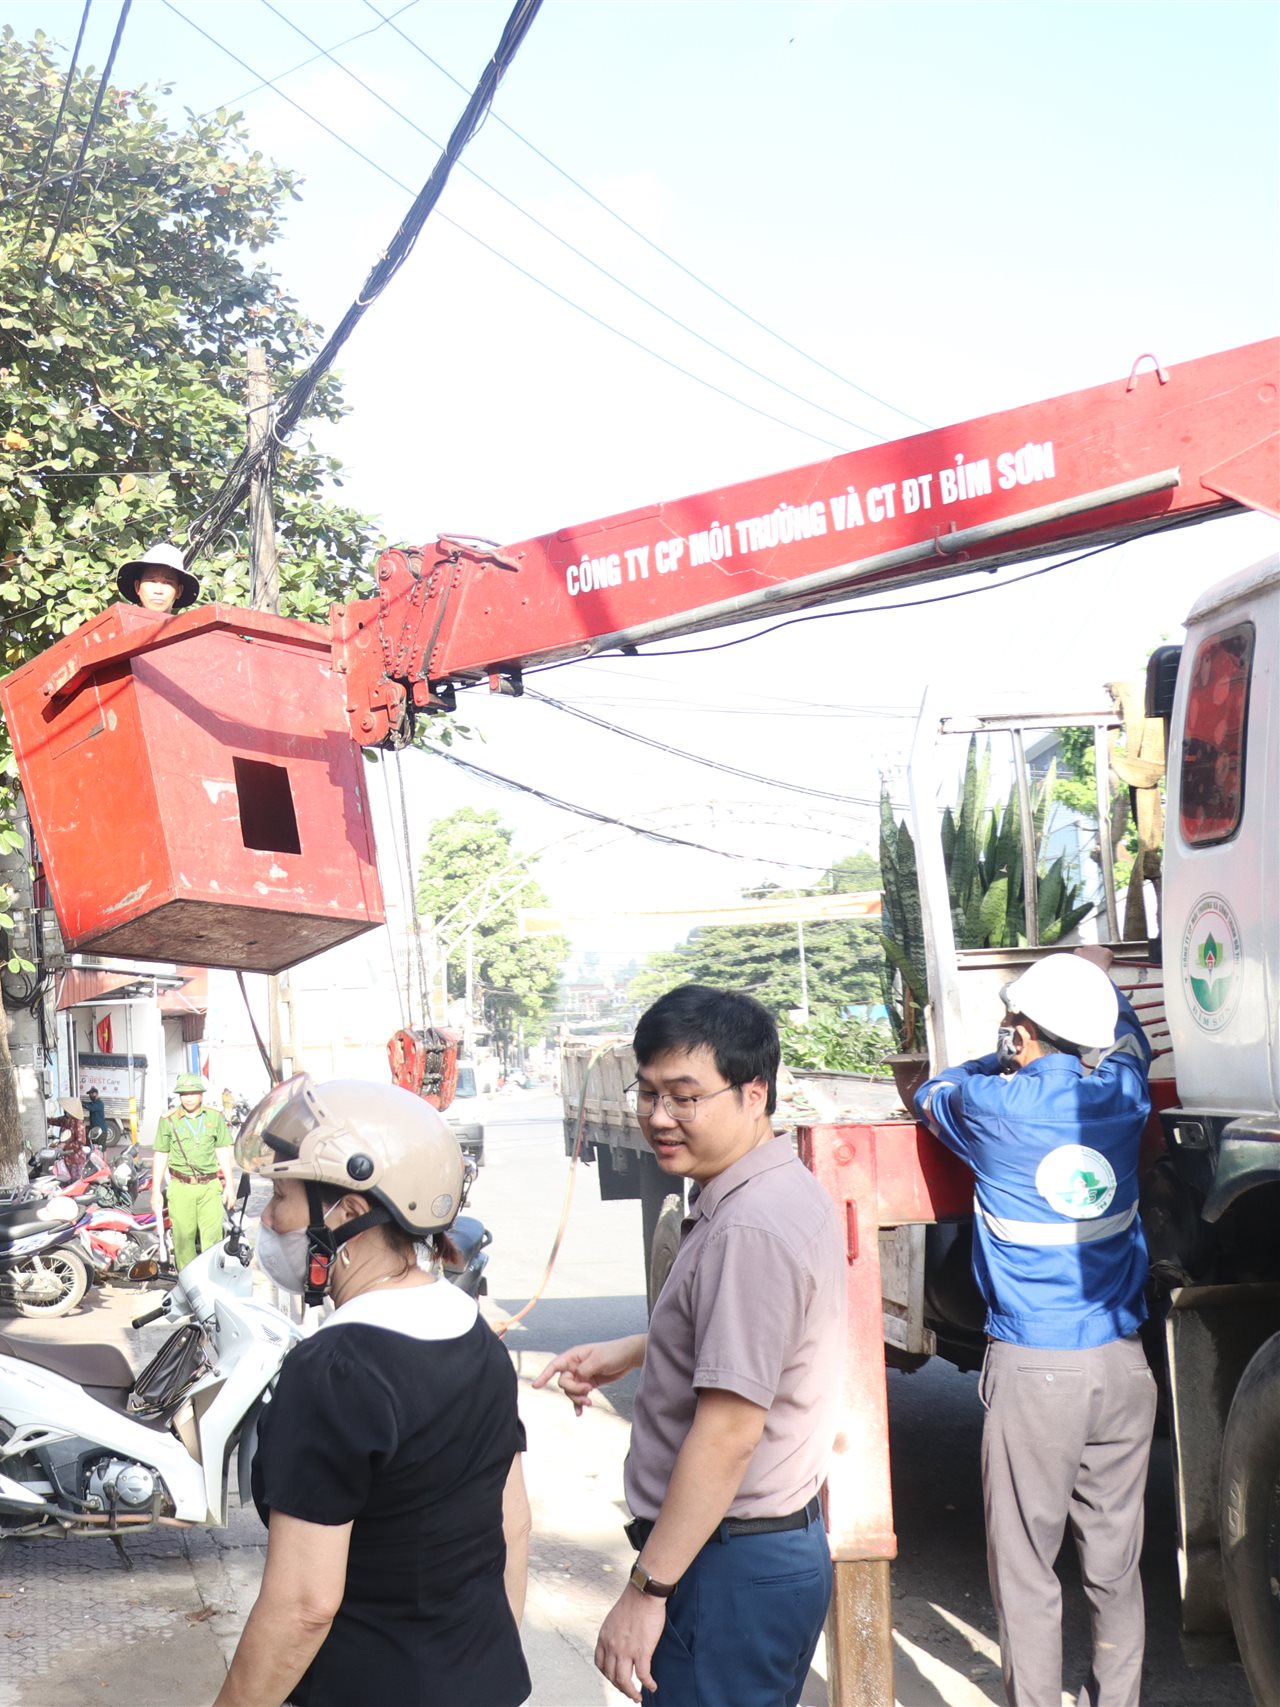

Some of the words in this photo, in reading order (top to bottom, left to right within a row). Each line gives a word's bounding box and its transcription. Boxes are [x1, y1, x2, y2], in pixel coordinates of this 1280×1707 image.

[566, 555, 622, 596] CÔNG
[624, 546, 650, 581] TY
[655, 537, 684, 574] CP
[688, 521, 733, 566] MÔI
[735, 501, 828, 554] TRƯỜNG
[830, 486, 865, 531] VÀ
[866, 483, 895, 523] CT
[902, 473, 933, 514] ĐT
[939, 453, 992, 505] BỈM
[996, 442, 1056, 490] SƠN
[106, 1078, 121, 1086] Care
